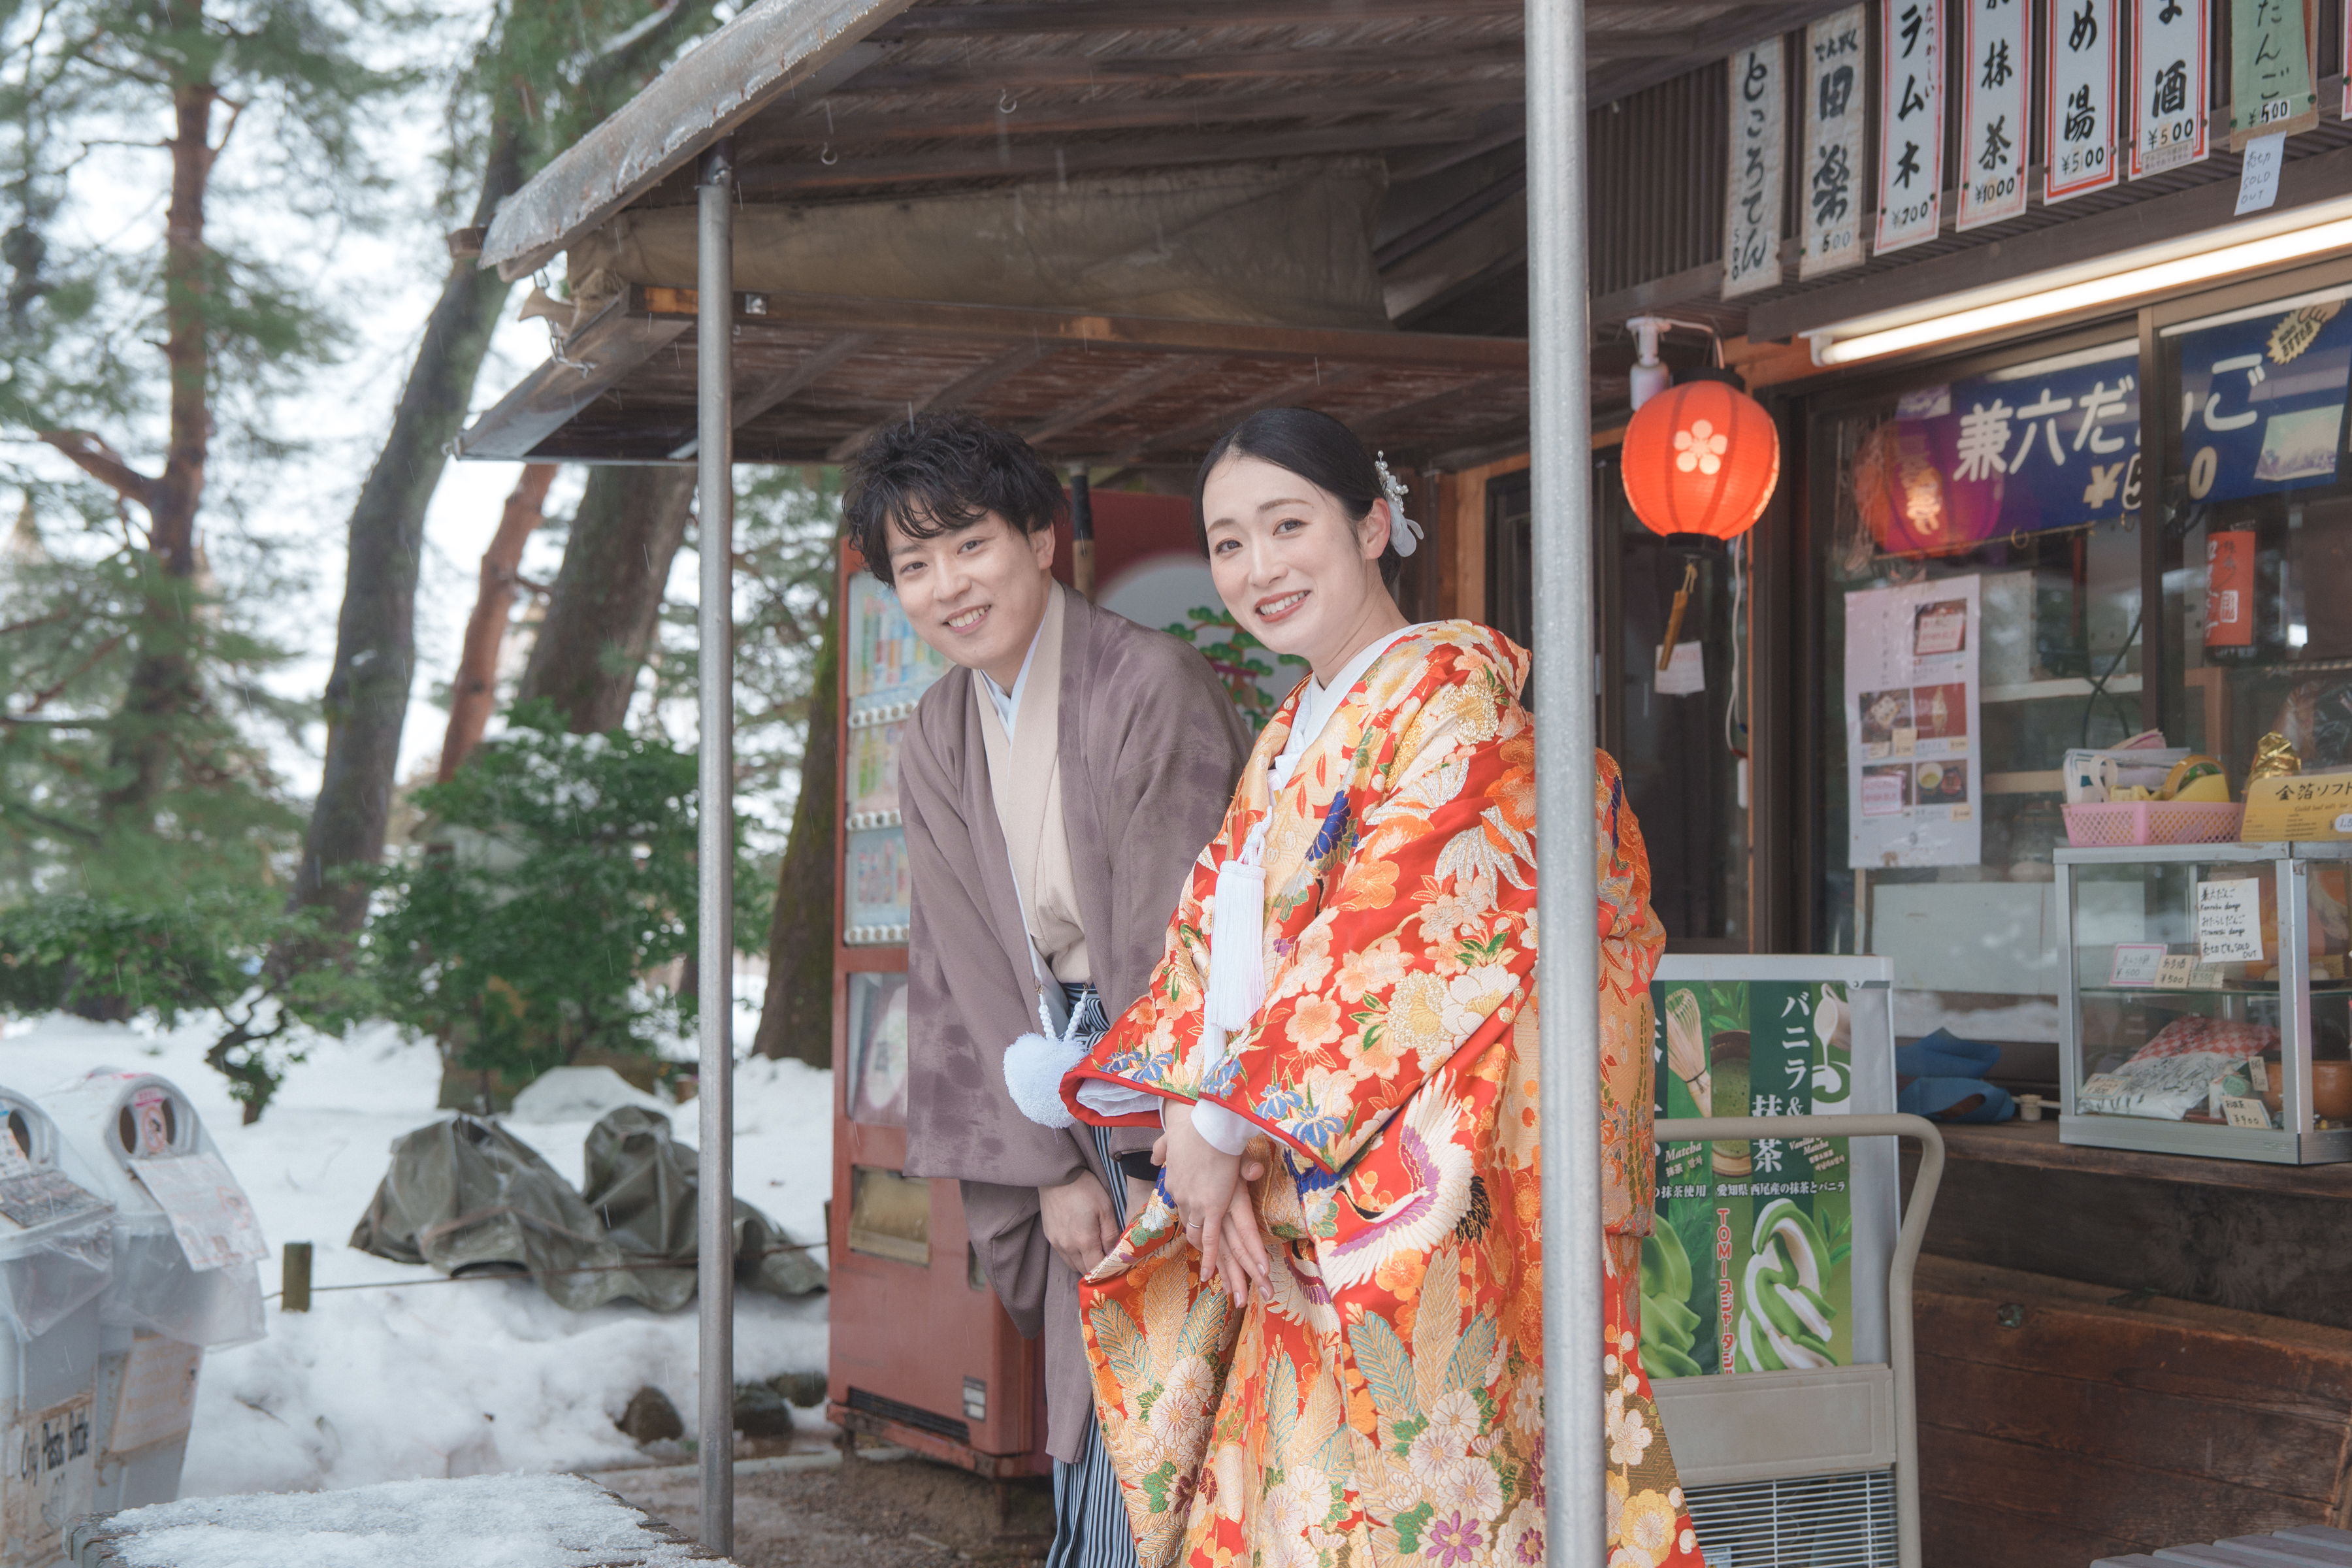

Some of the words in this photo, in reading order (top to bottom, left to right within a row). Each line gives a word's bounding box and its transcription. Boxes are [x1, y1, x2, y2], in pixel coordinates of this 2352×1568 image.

[1979, 0, 2013, 170] 抹茶
[2148, 119, 2193, 151] ¥500
[1742, 52, 1768, 272] ところてん
[2062, 146, 2104, 175] ¥500
[2243, 171, 2270, 190] SOLD
[2241, 189, 2264, 204] OUT
[1665, 1141, 1703, 1163] Matcha
[1716, 1183, 1748, 1198] 愛知県
[1750, 1181, 1846, 1196] 西尾産の抹茶とバニラ
